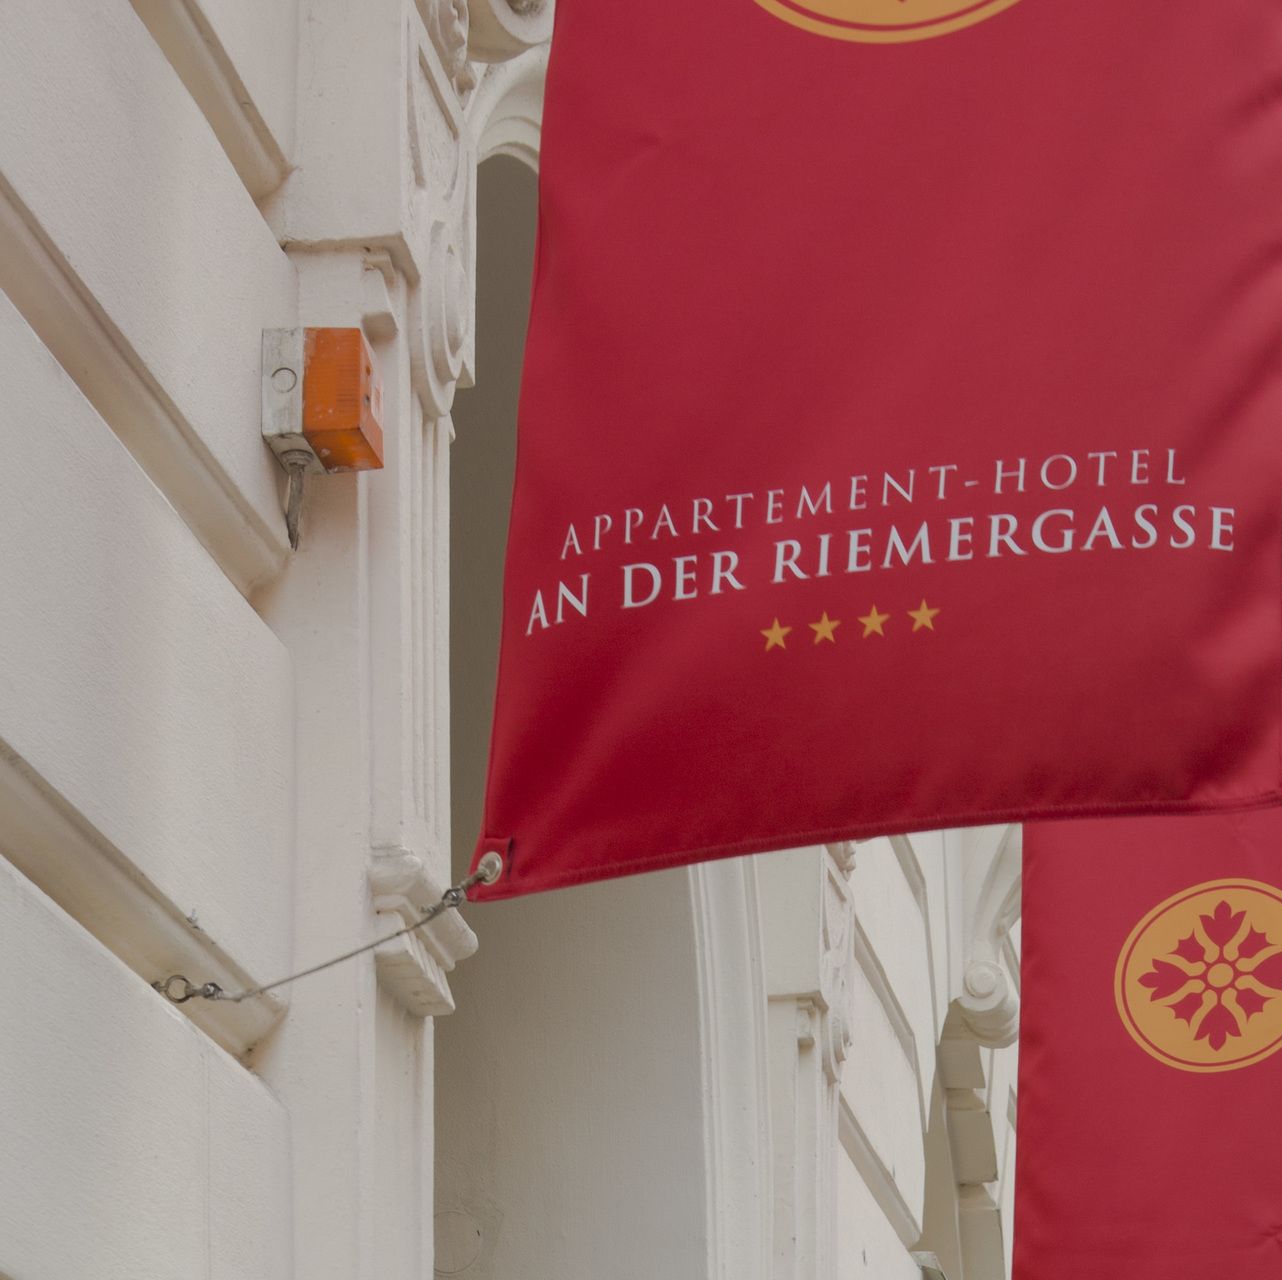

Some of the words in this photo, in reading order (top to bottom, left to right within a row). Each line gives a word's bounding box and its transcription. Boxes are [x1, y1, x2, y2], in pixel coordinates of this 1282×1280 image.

[560, 447, 1186, 559] APPARTEMENT-HOTEL
[526, 574, 588, 635] AN
[621, 550, 743, 609] DER
[772, 504, 1236, 583] RIEMERGASSE
